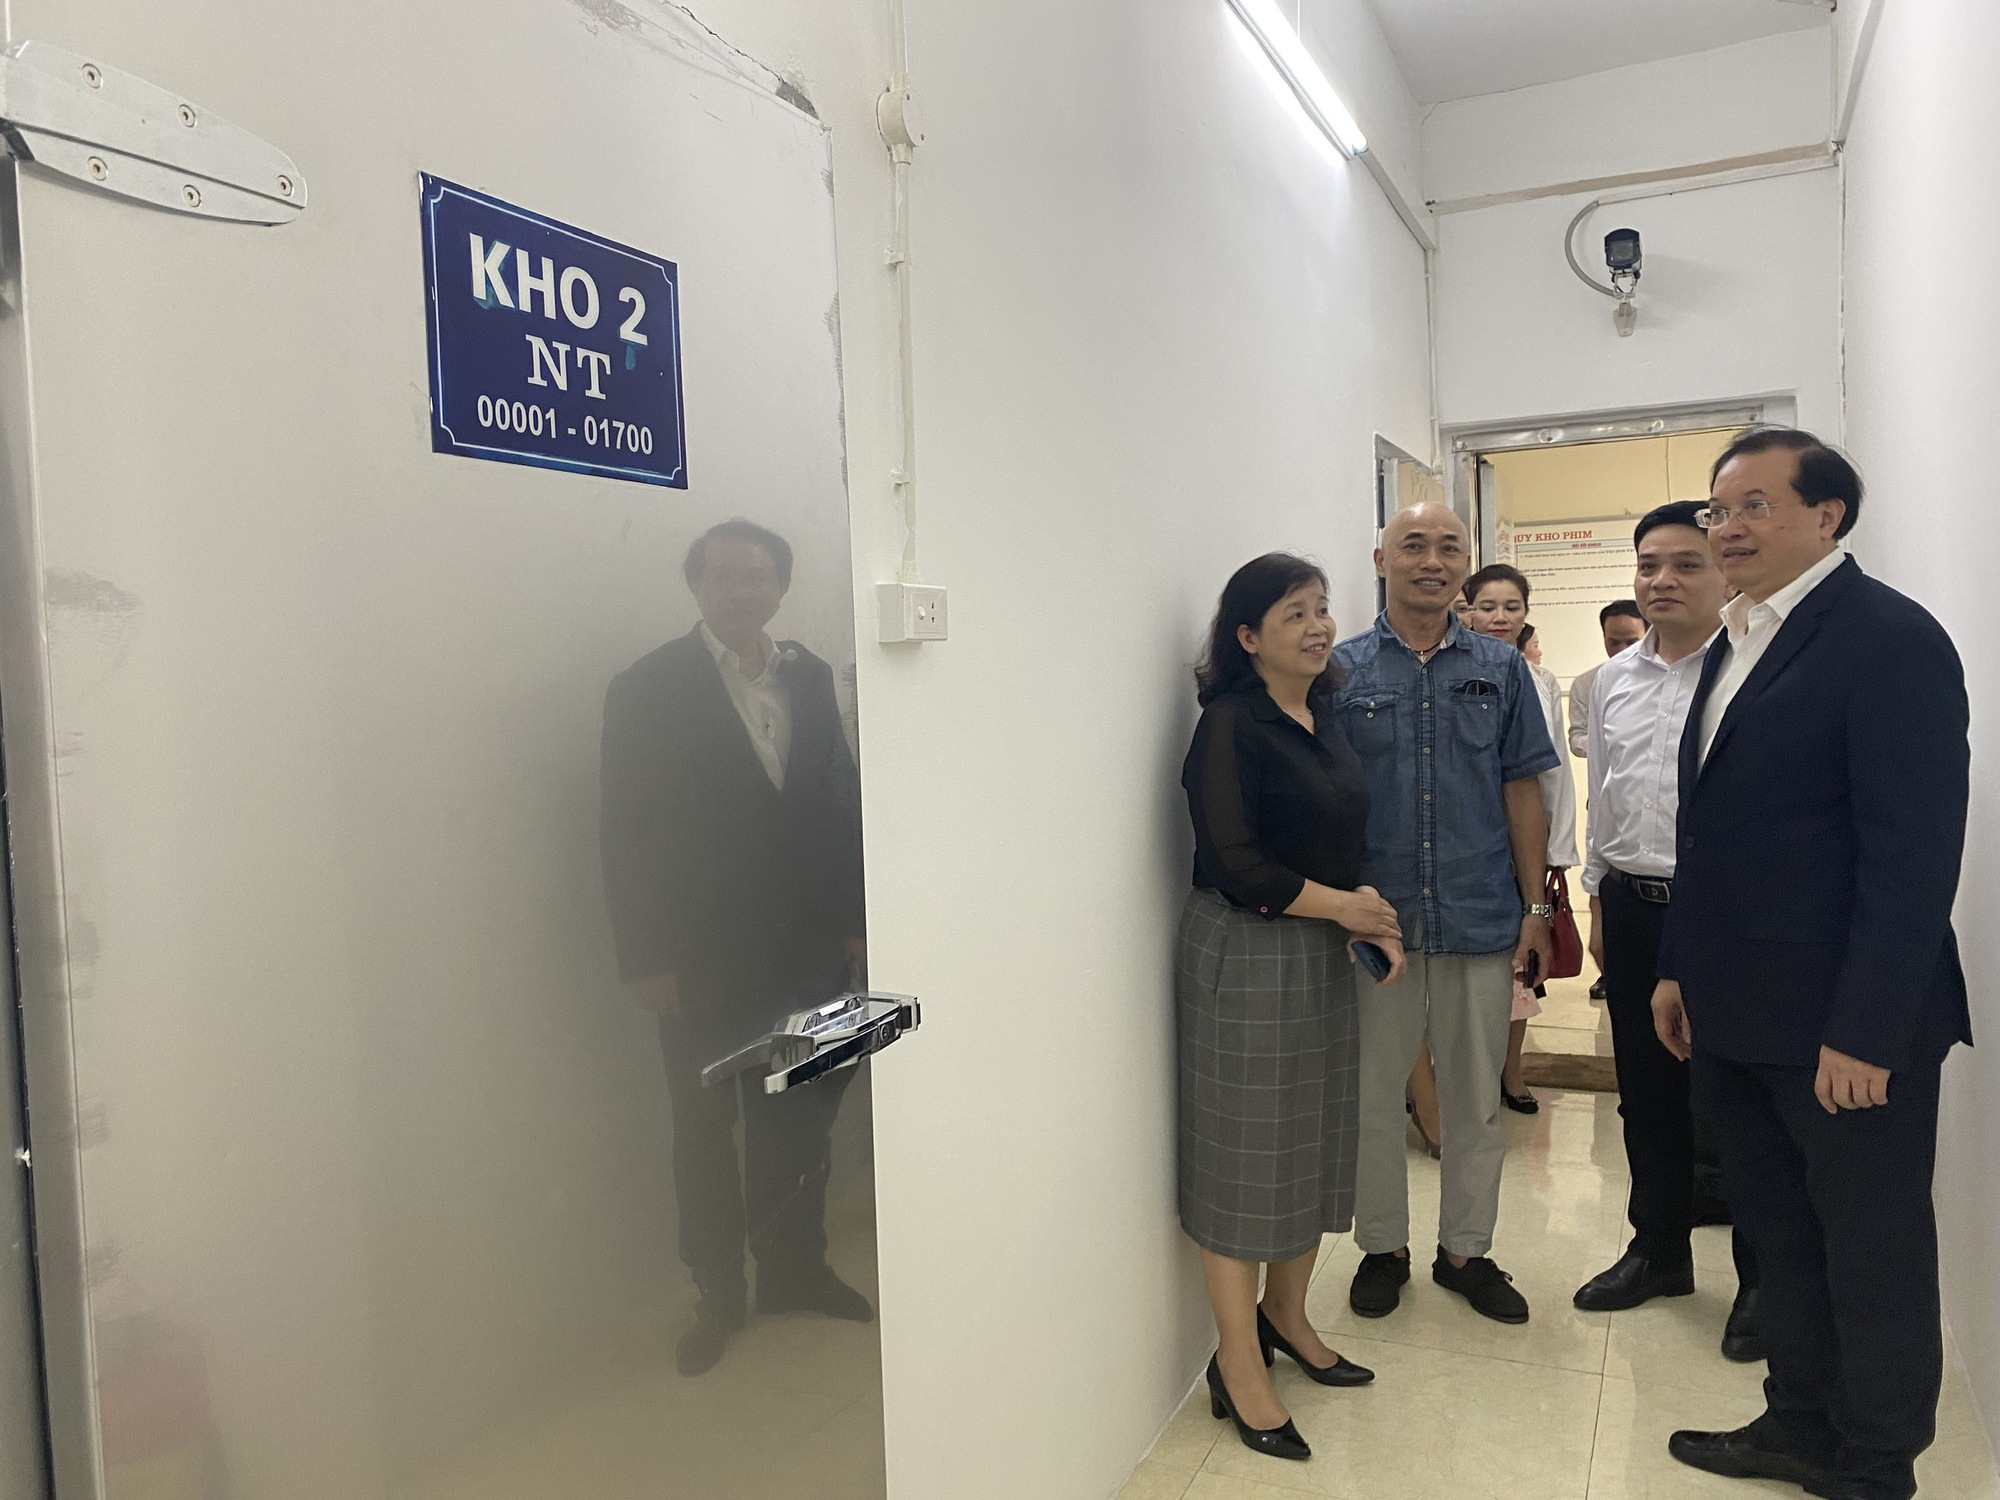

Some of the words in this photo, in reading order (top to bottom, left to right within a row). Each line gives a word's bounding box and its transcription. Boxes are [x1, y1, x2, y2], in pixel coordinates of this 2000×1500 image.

[469, 232, 600, 330] KHO
[618, 286, 648, 346] 2
[525, 334, 611, 400] NT
[477, 394, 557, 439] 00001
[584, 415, 653, 455] 01700
[1514, 533, 1532, 543] UY
[1535, 532, 1560, 542] KHO
[1563, 530, 1592, 540] PHIM
